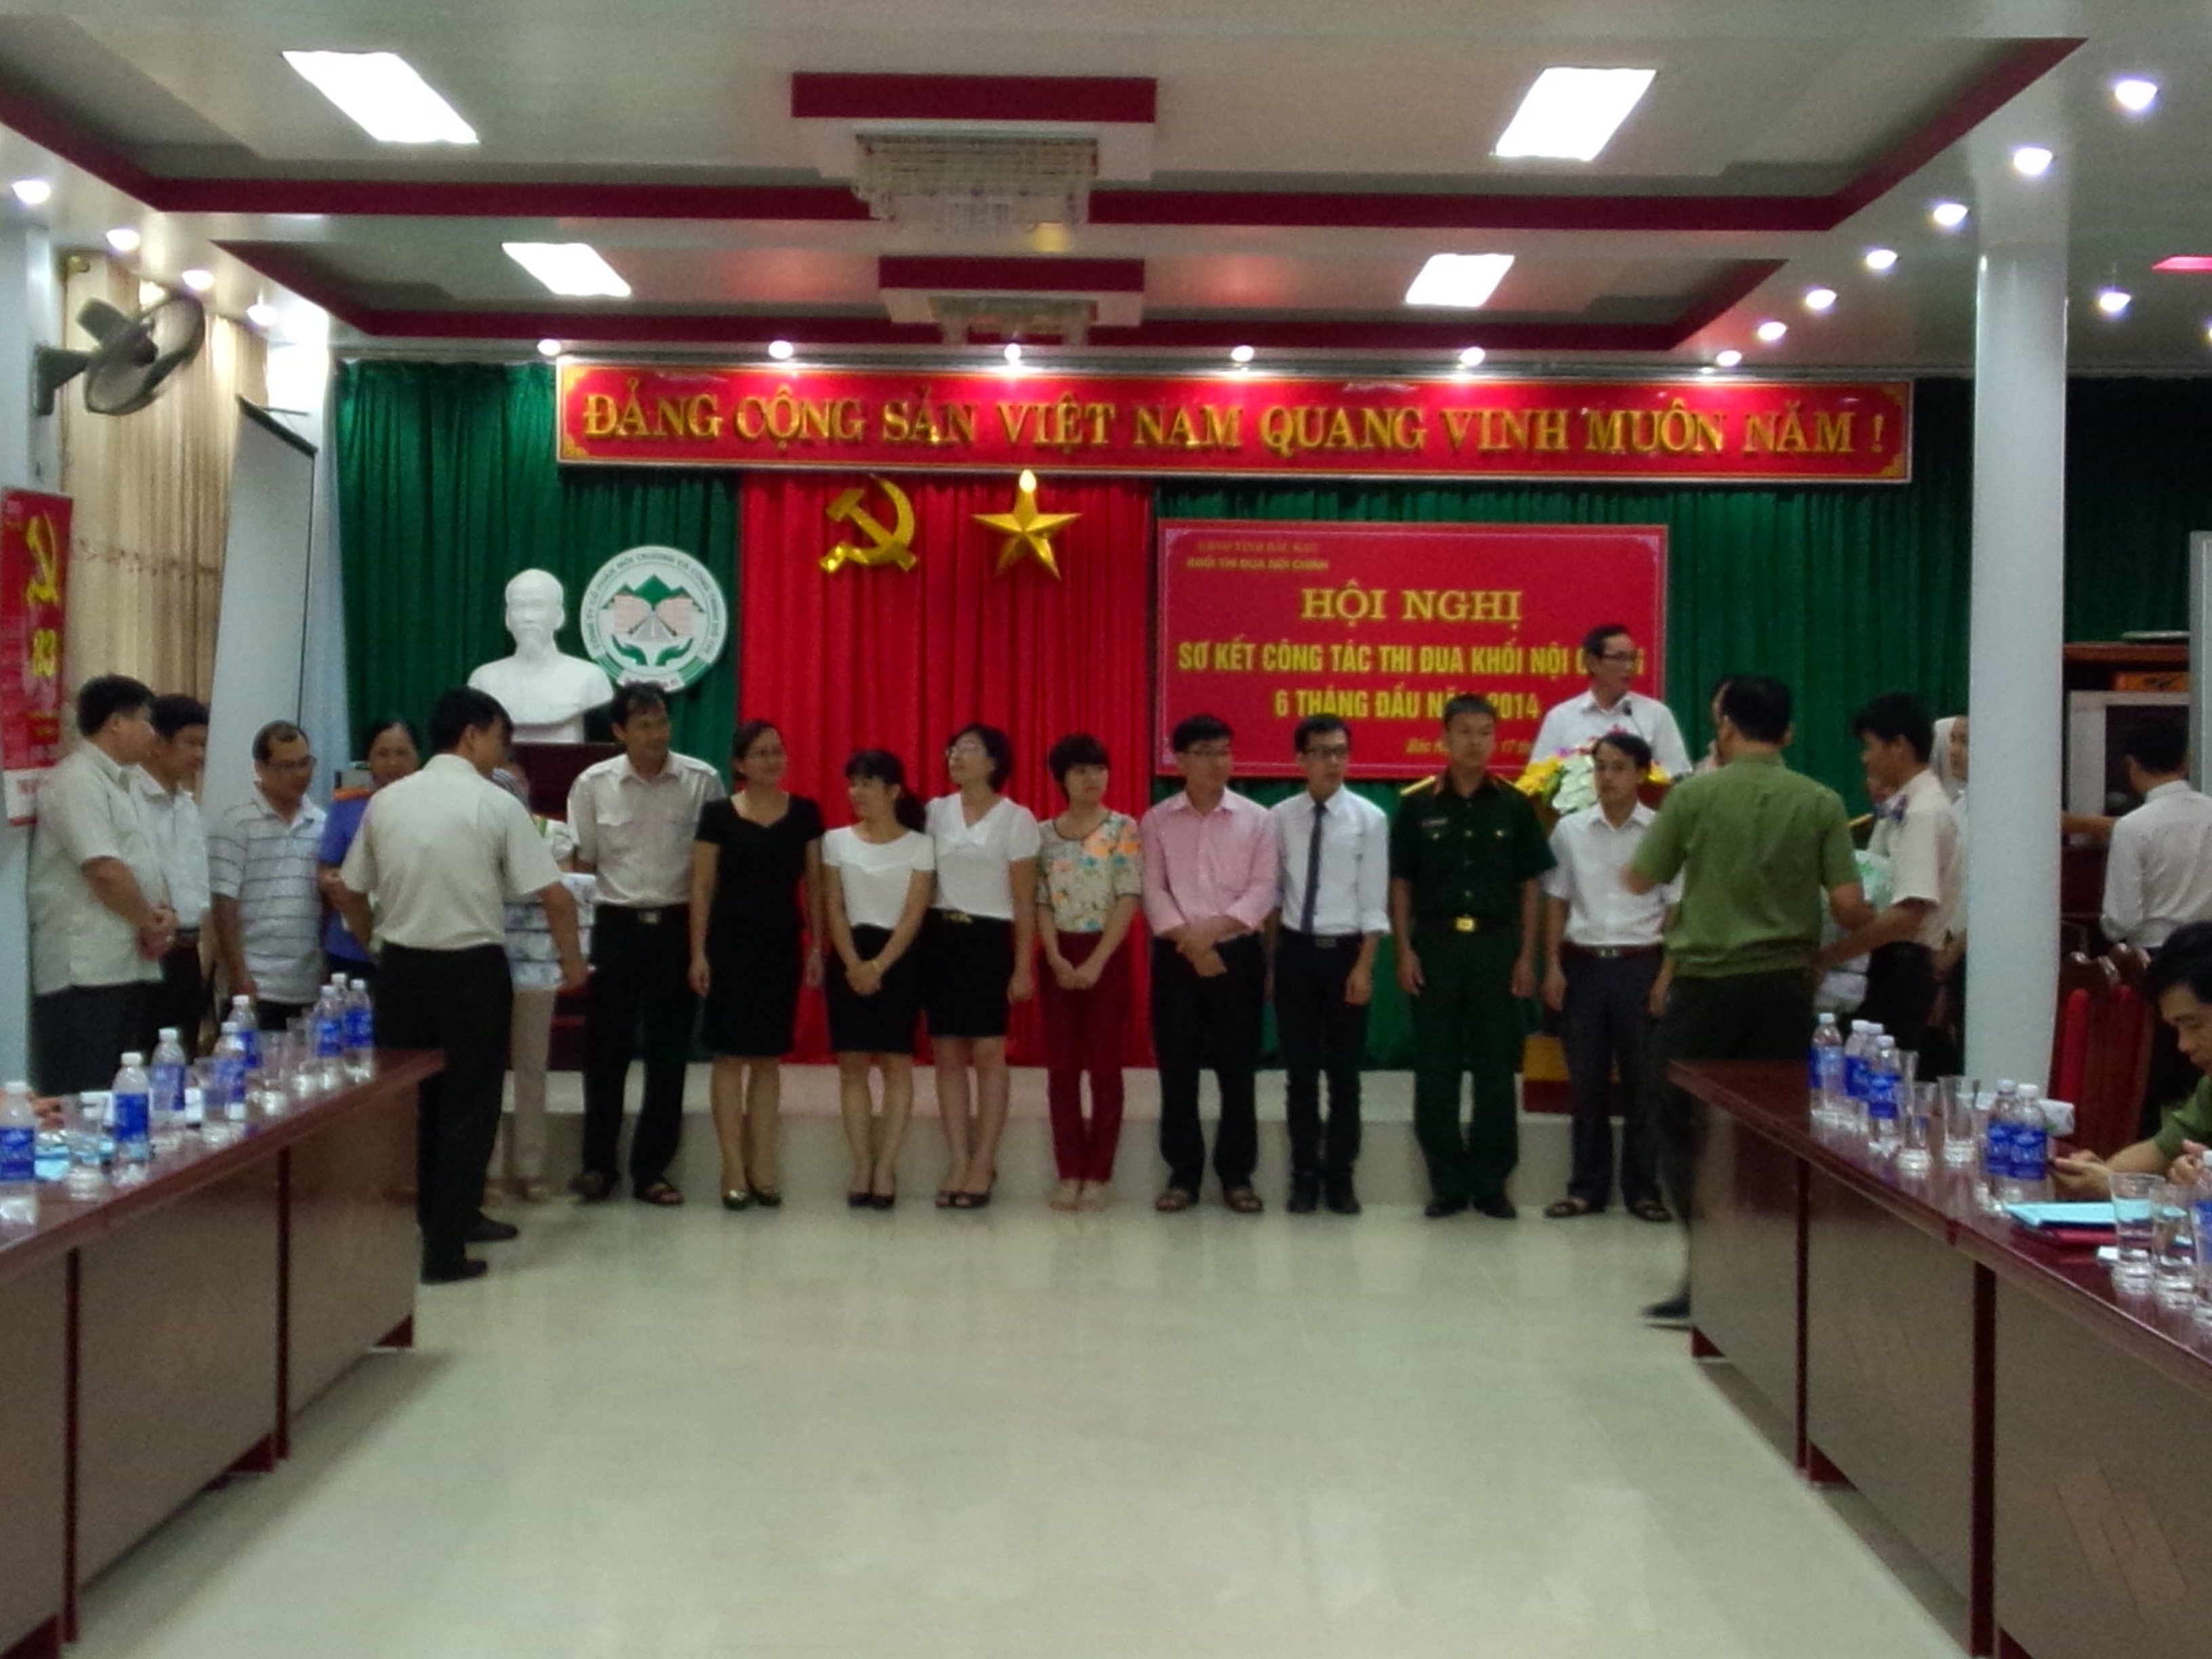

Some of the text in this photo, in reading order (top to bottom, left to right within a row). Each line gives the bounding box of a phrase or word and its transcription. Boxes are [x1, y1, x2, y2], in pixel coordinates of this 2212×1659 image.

[585, 377, 1884, 457] ĐẢNG CỘNG SẢN VIỆT NAM QUANG VINH MUÔN NĂM !
[1300, 578, 1523, 631] HỘI NGHỊ
[1178, 640, 1209, 670] SƠ
[1214, 632, 1254, 671] KẾT
[1262, 636, 1322, 672] CÔNG
[1330, 639, 1371, 672] TÁC
[1379, 645, 1413, 673] THI
[1420, 646, 1464, 674] ĐUA
[1471, 638, 1523, 674] KHỐI
[1530, 641, 1568, 680] NỘI
[1274, 690, 1288, 717] 6
[1296, 684, 1368, 718] THÁNG
